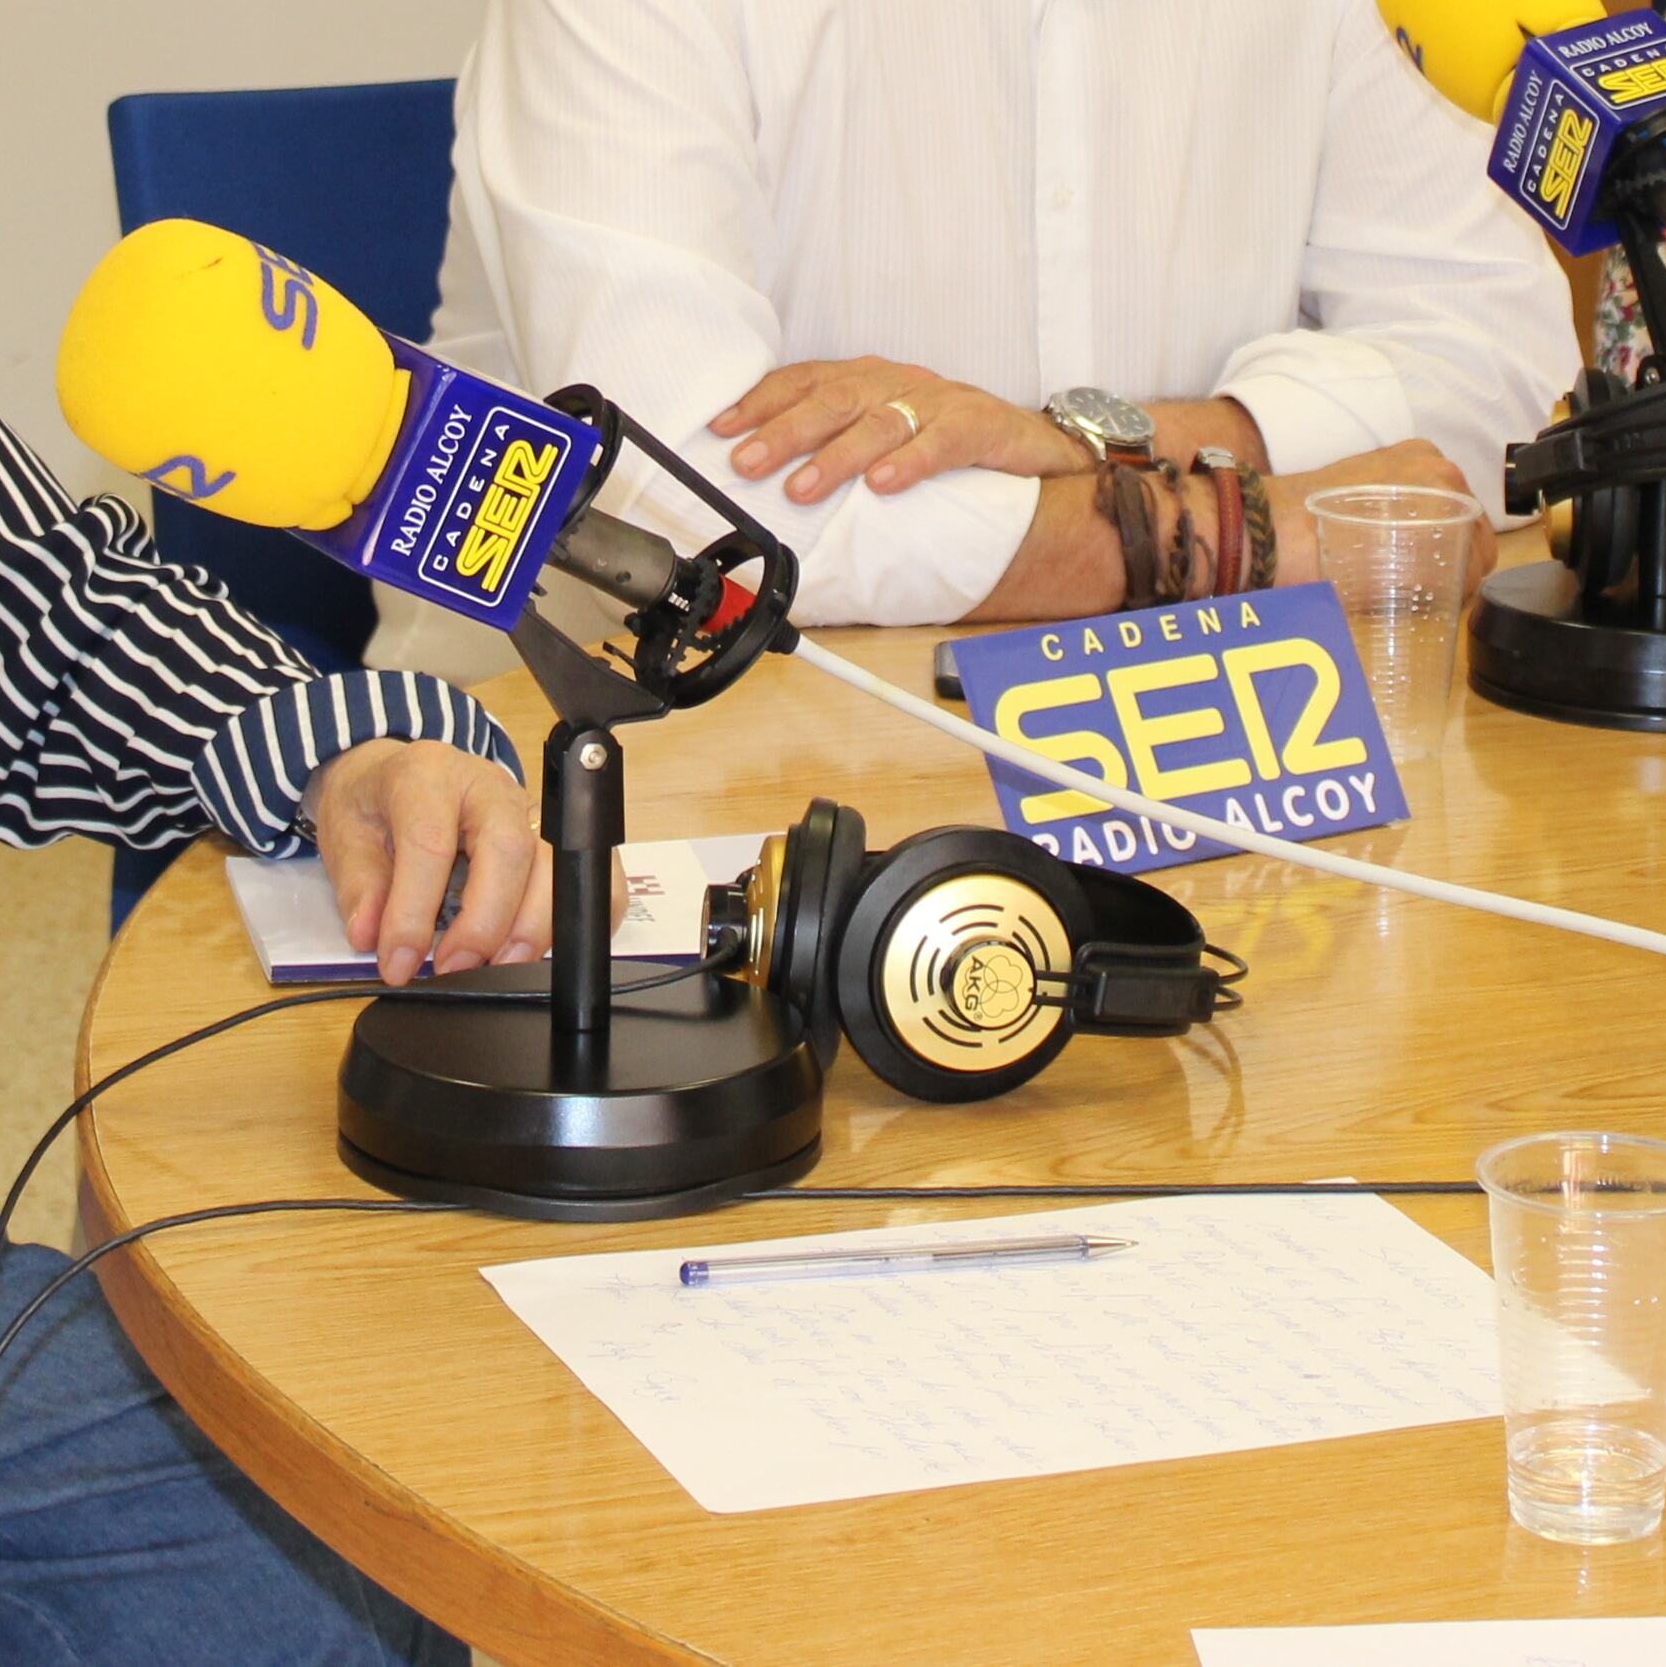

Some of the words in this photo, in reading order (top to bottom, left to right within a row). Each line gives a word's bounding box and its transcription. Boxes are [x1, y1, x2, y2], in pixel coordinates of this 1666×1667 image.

[1558, 36, 1607, 59] RADIO
[1607, 22, 1654, 46] ALCOY
[1503, 127, 1527, 174] RADIO
[1520, 70, 1544, 126] ALCOY
[1527, 93, 1565, 194] CADENA
[1540, 108, 1593, 219] SER
[391, 484, 438, 557] RADIO
[426, 404, 472, 484] ALCOY
[433, 424, 510, 572] CADENA
[456, 439, 559, 593] SER
[1040, 601, 1262, 662] CADENA
[995, 637, 1369, 825] SER
[1224, 771, 1377, 835] ALCOY
[964, 955, 985, 1011] AKG
